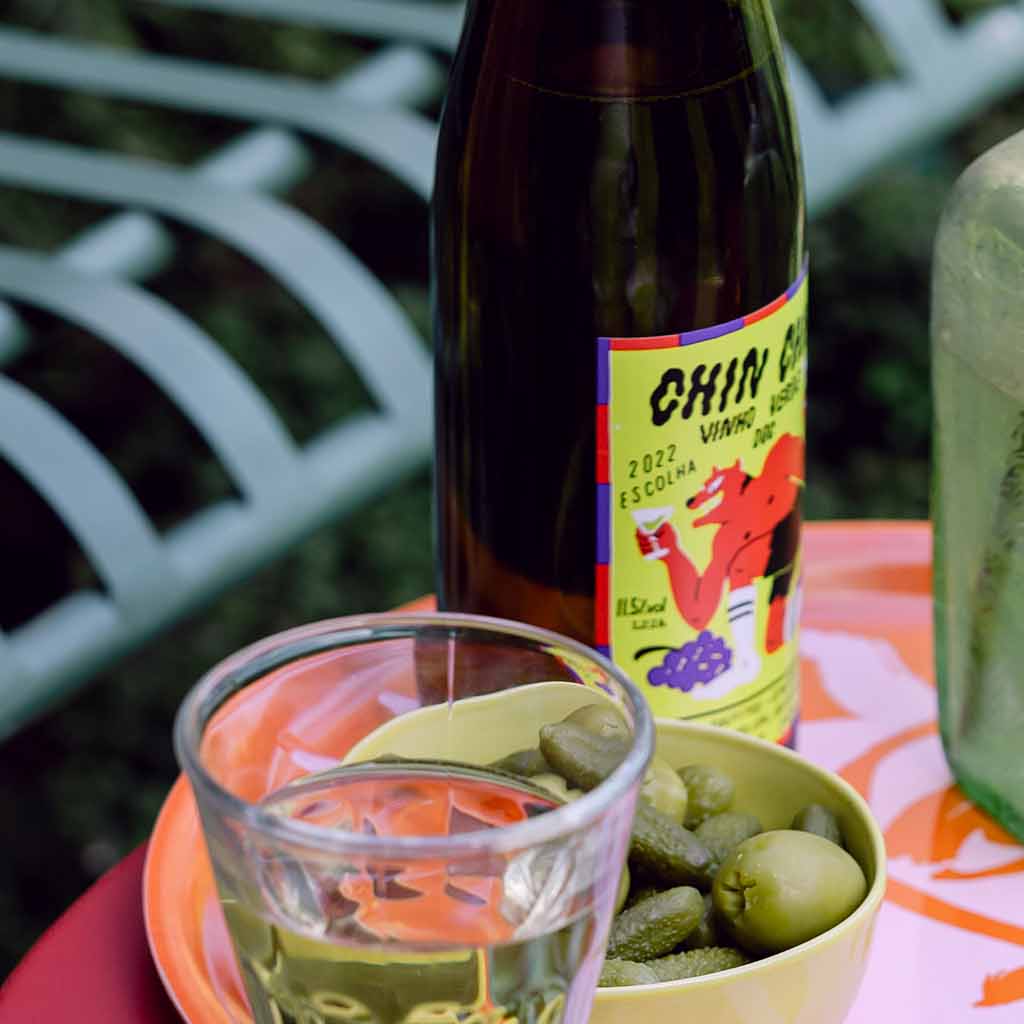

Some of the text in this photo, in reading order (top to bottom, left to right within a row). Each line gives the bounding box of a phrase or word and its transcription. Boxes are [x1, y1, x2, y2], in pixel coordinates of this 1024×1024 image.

[650, 347, 769, 427] CHIN
[700, 405, 756, 444] VINHO
[628, 443, 677, 479] 2022
[619, 459, 697, 510] ESCOLHA
